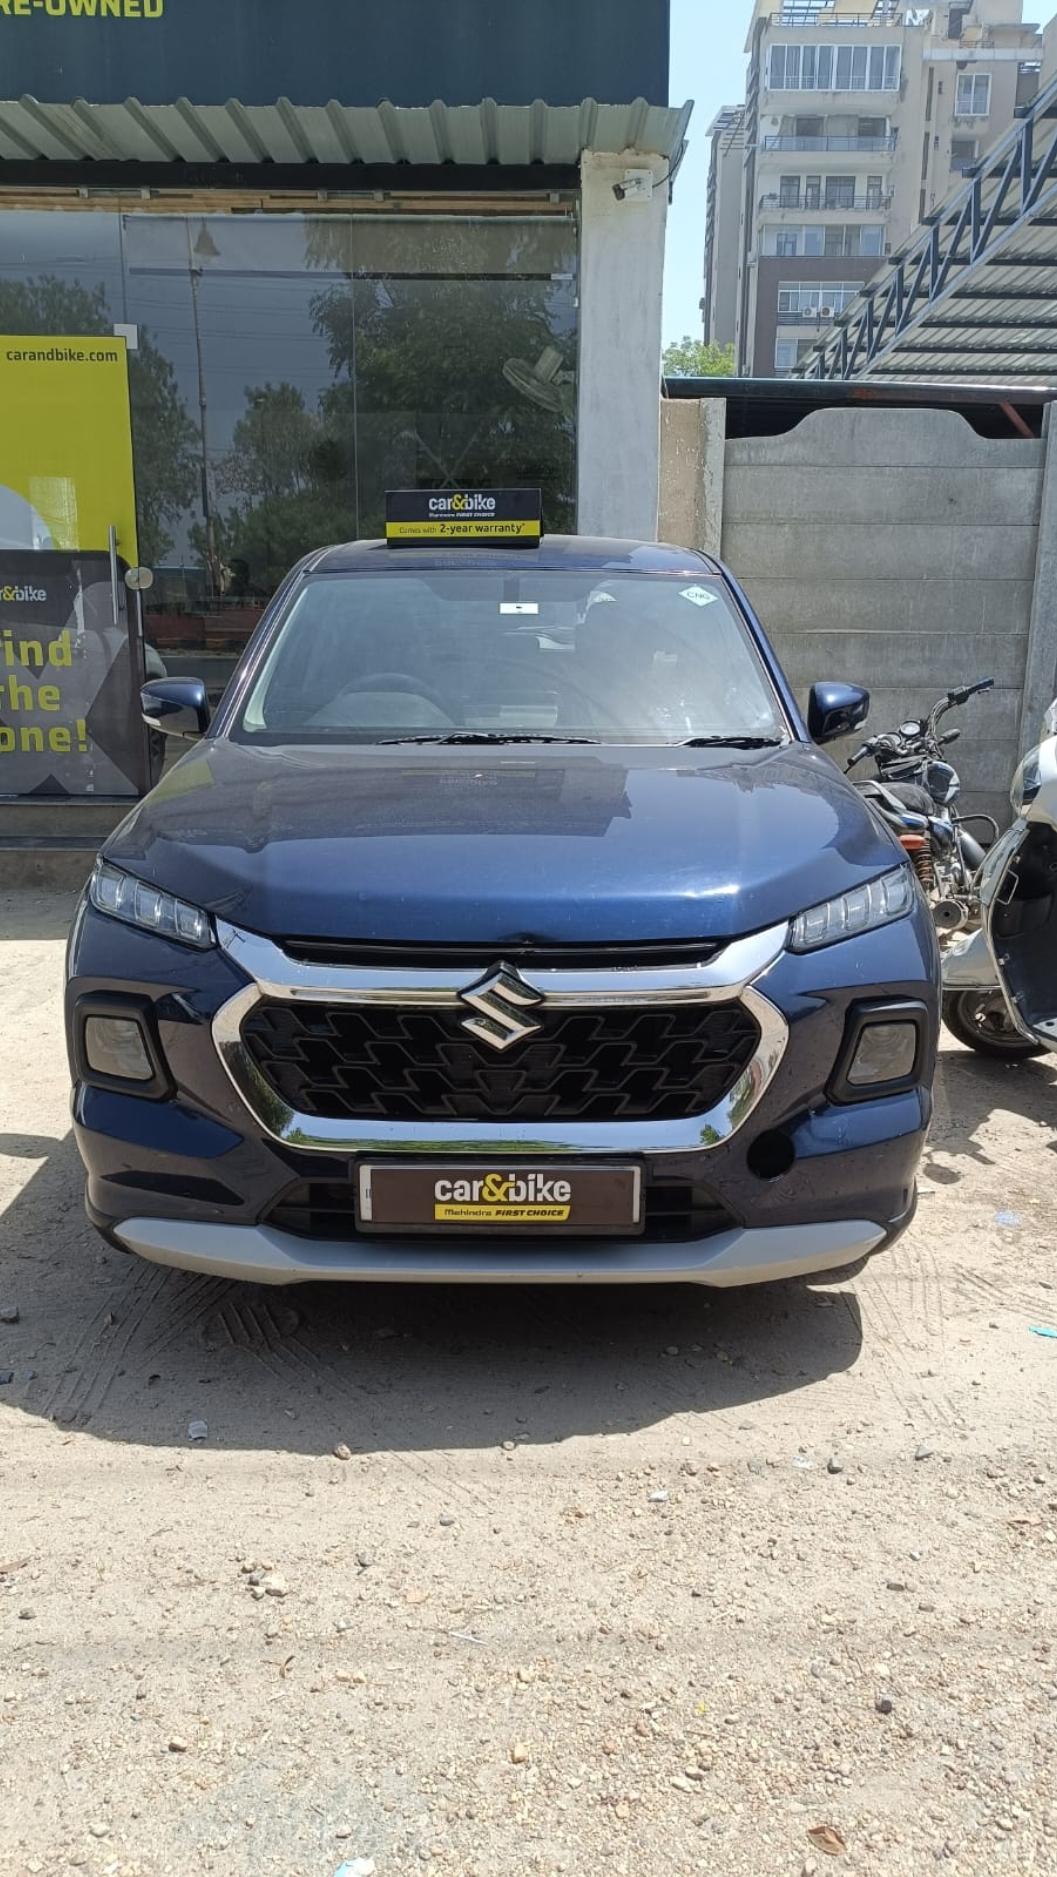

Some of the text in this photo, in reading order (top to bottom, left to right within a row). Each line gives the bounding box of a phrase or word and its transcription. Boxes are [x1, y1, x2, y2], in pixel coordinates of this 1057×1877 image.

[6, 348, 118, 361] carandbike.com
[428, 494, 496, 511] car&bike
[440, 523, 473, 534] 2-year
[0, 629, 73, 667] ind
[0, 718, 88, 752] one!
[434, 1173, 571, 1202] car&bike
[495, 1209, 526, 1217] FIRST
[526, 1209, 564, 1217] CHOICE
